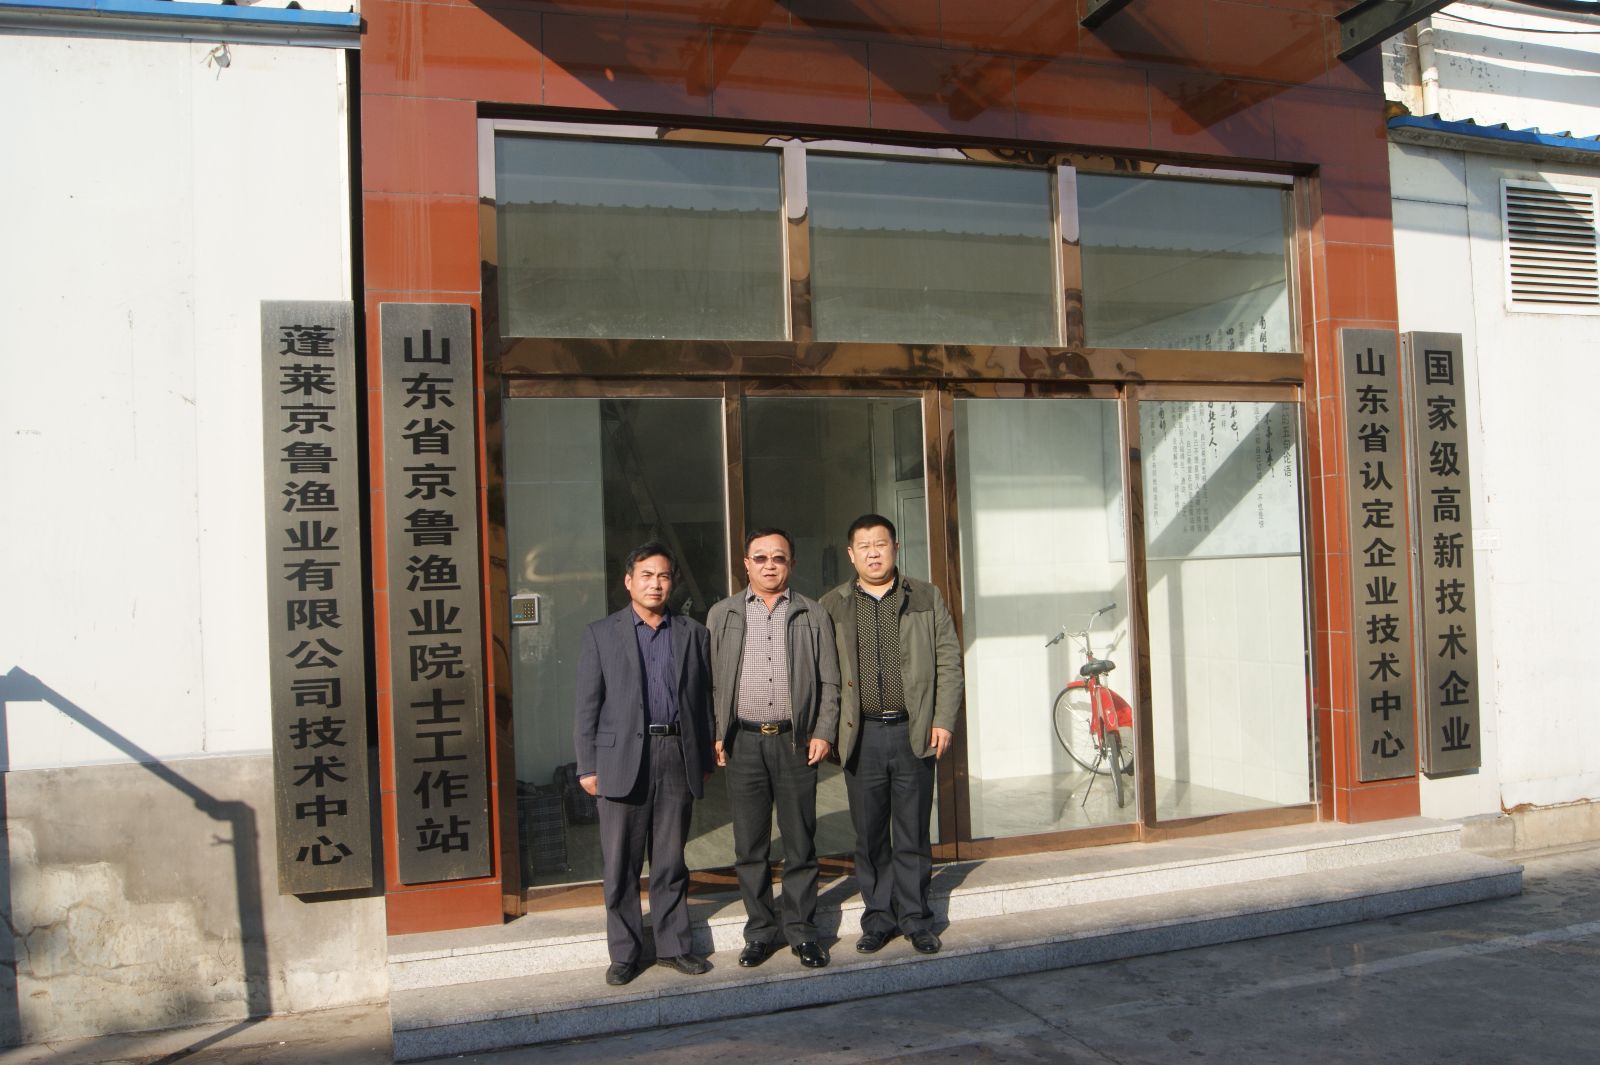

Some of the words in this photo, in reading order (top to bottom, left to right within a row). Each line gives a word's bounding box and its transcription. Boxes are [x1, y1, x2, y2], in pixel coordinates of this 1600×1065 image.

[280, 324, 353, 866] 蓬莱京鲁渔业有限公司技术中心
[402, 329, 471, 853] 山东省京鲁渔业院士工作站
[1356, 348, 1405, 758] 山东省认定企业技术中心
[1424, 349, 1471, 752] 国家级高新技术企业
